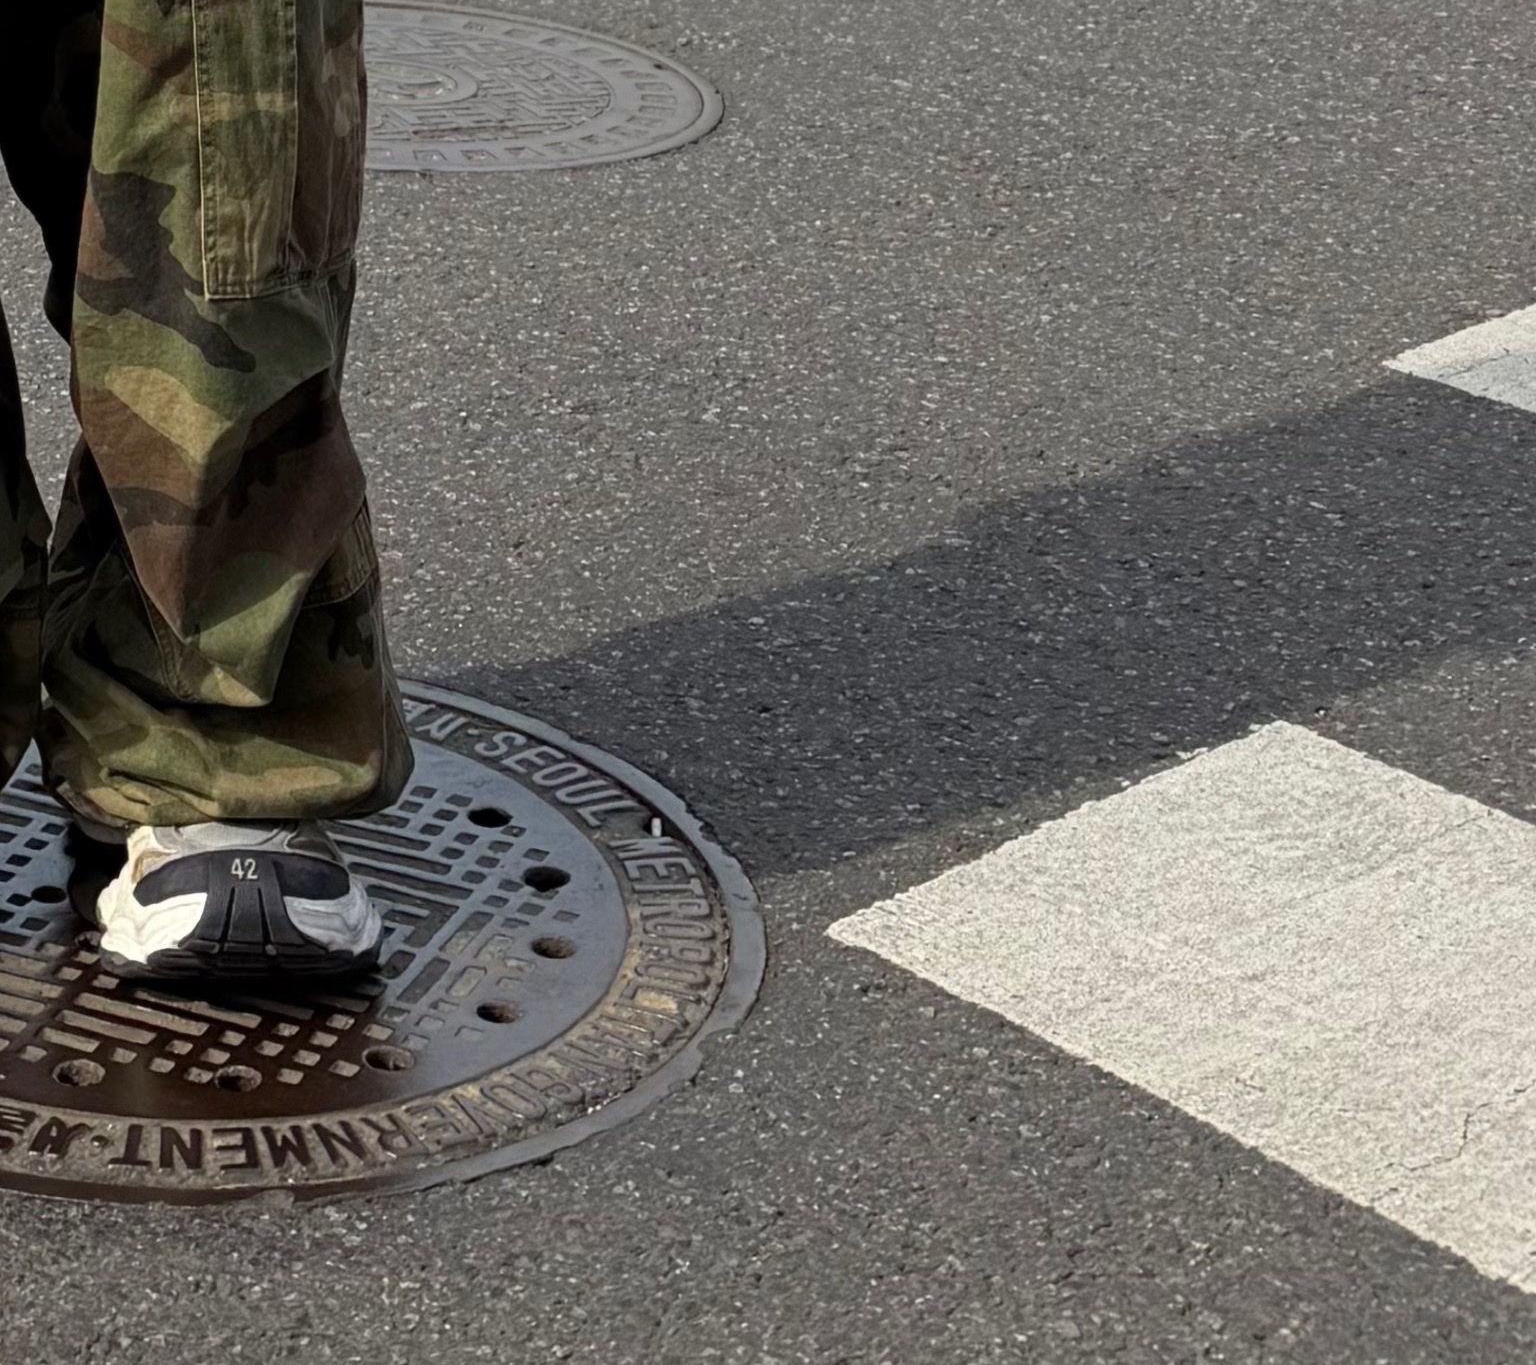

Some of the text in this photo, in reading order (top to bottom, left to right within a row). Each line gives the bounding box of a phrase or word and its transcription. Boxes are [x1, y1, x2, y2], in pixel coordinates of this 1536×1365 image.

[108, 729, 717, 1170] SEOUL METROPOLITAN GOVERNMENT
[231, 857, 259, 881] 42
